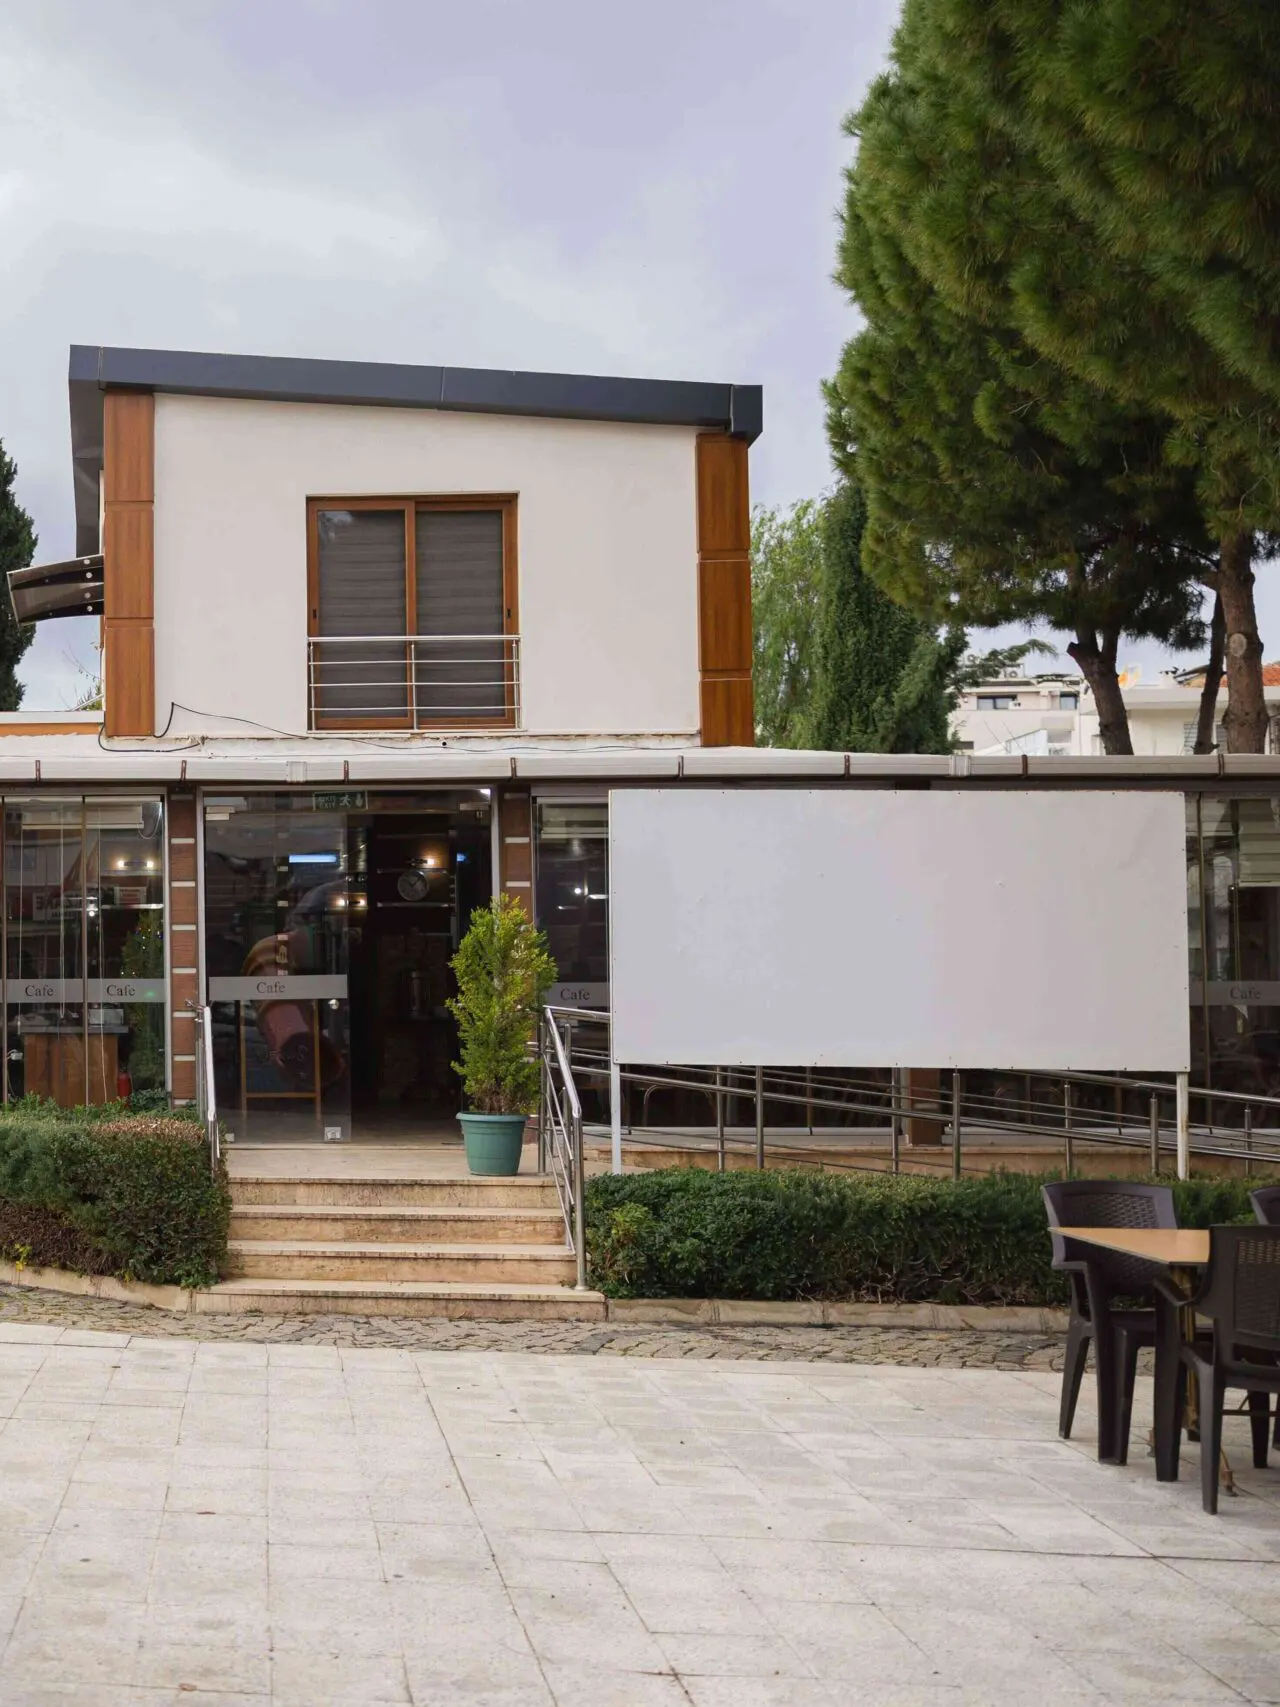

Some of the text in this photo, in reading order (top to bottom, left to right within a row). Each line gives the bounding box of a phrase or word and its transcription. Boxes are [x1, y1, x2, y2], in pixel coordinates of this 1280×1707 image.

[24, 984, 55, 997] Cafe
[106, 984, 136, 997] Cafe
[256, 981, 286, 994] Cafe
[560, 988, 591, 1000] Cafe
[1230, 986, 1261, 1000] Cafe
